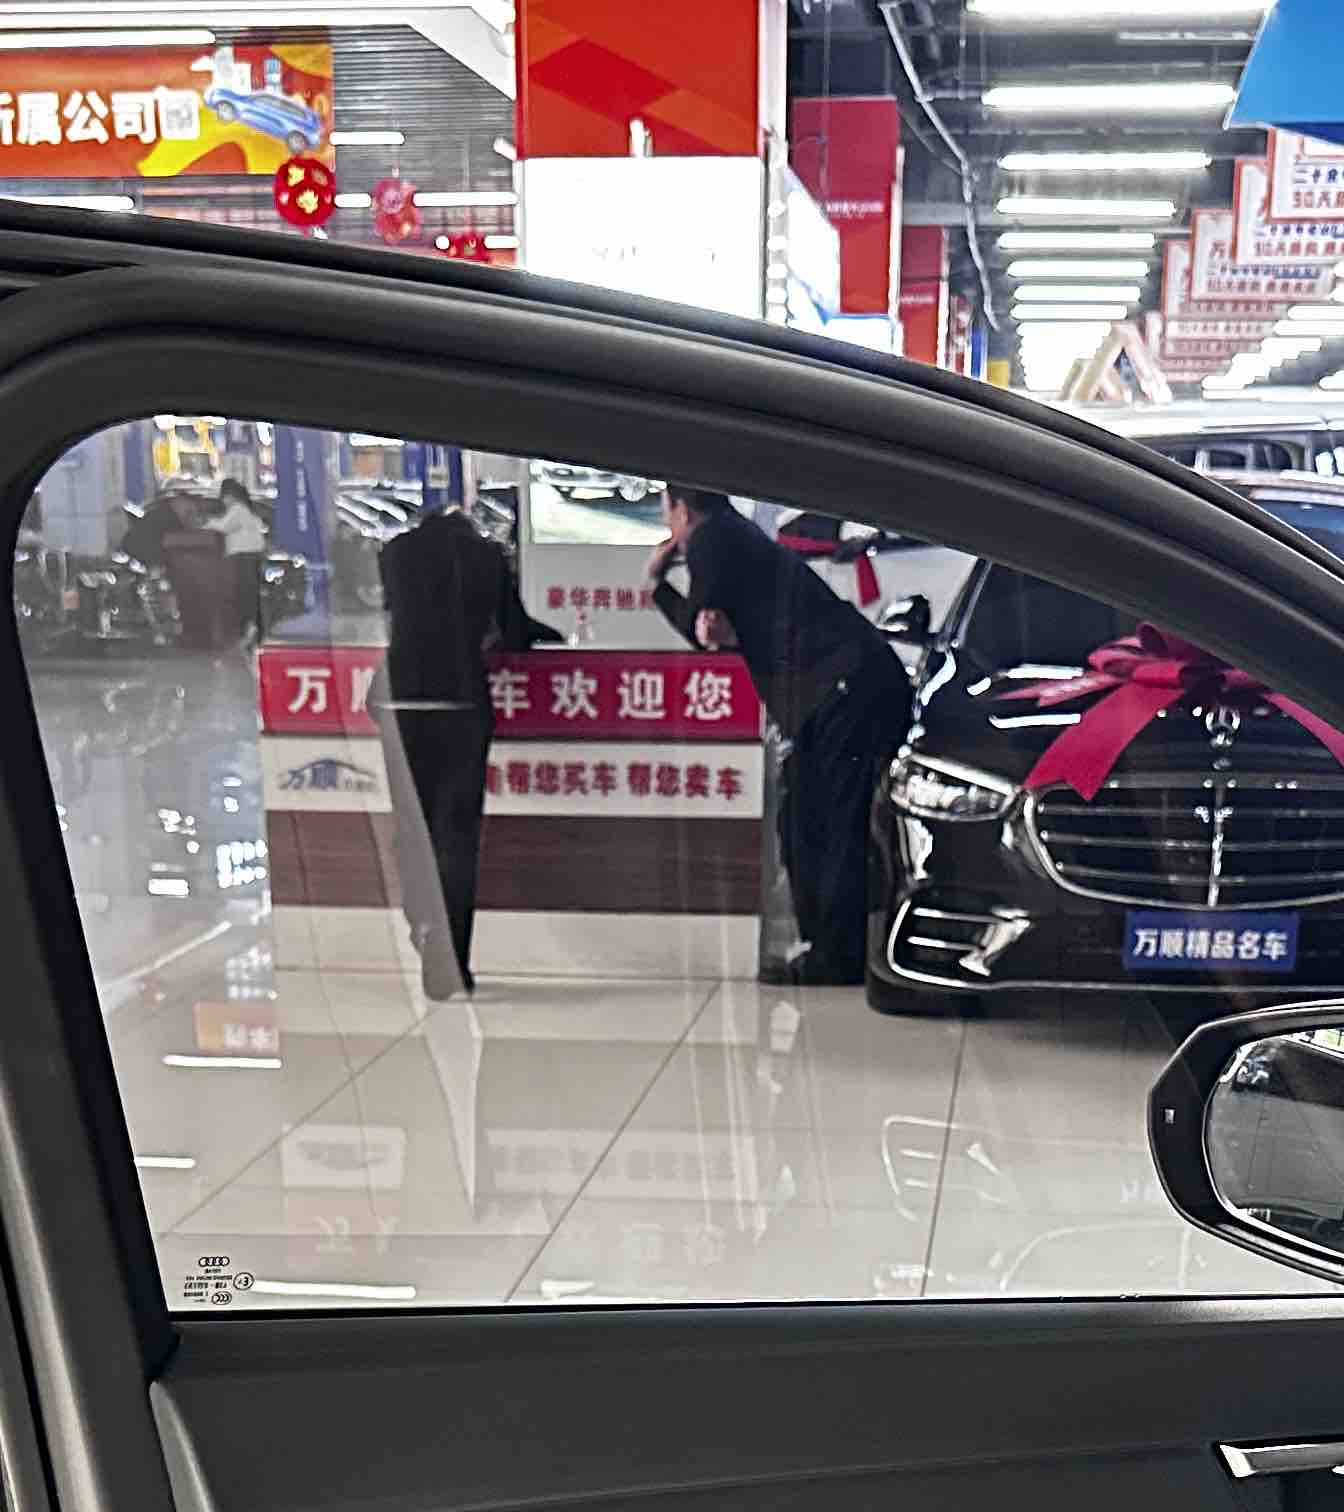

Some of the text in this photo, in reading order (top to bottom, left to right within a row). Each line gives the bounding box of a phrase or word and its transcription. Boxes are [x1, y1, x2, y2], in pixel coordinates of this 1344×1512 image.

[1133, 927, 1289, 960] 万顺精品名车
